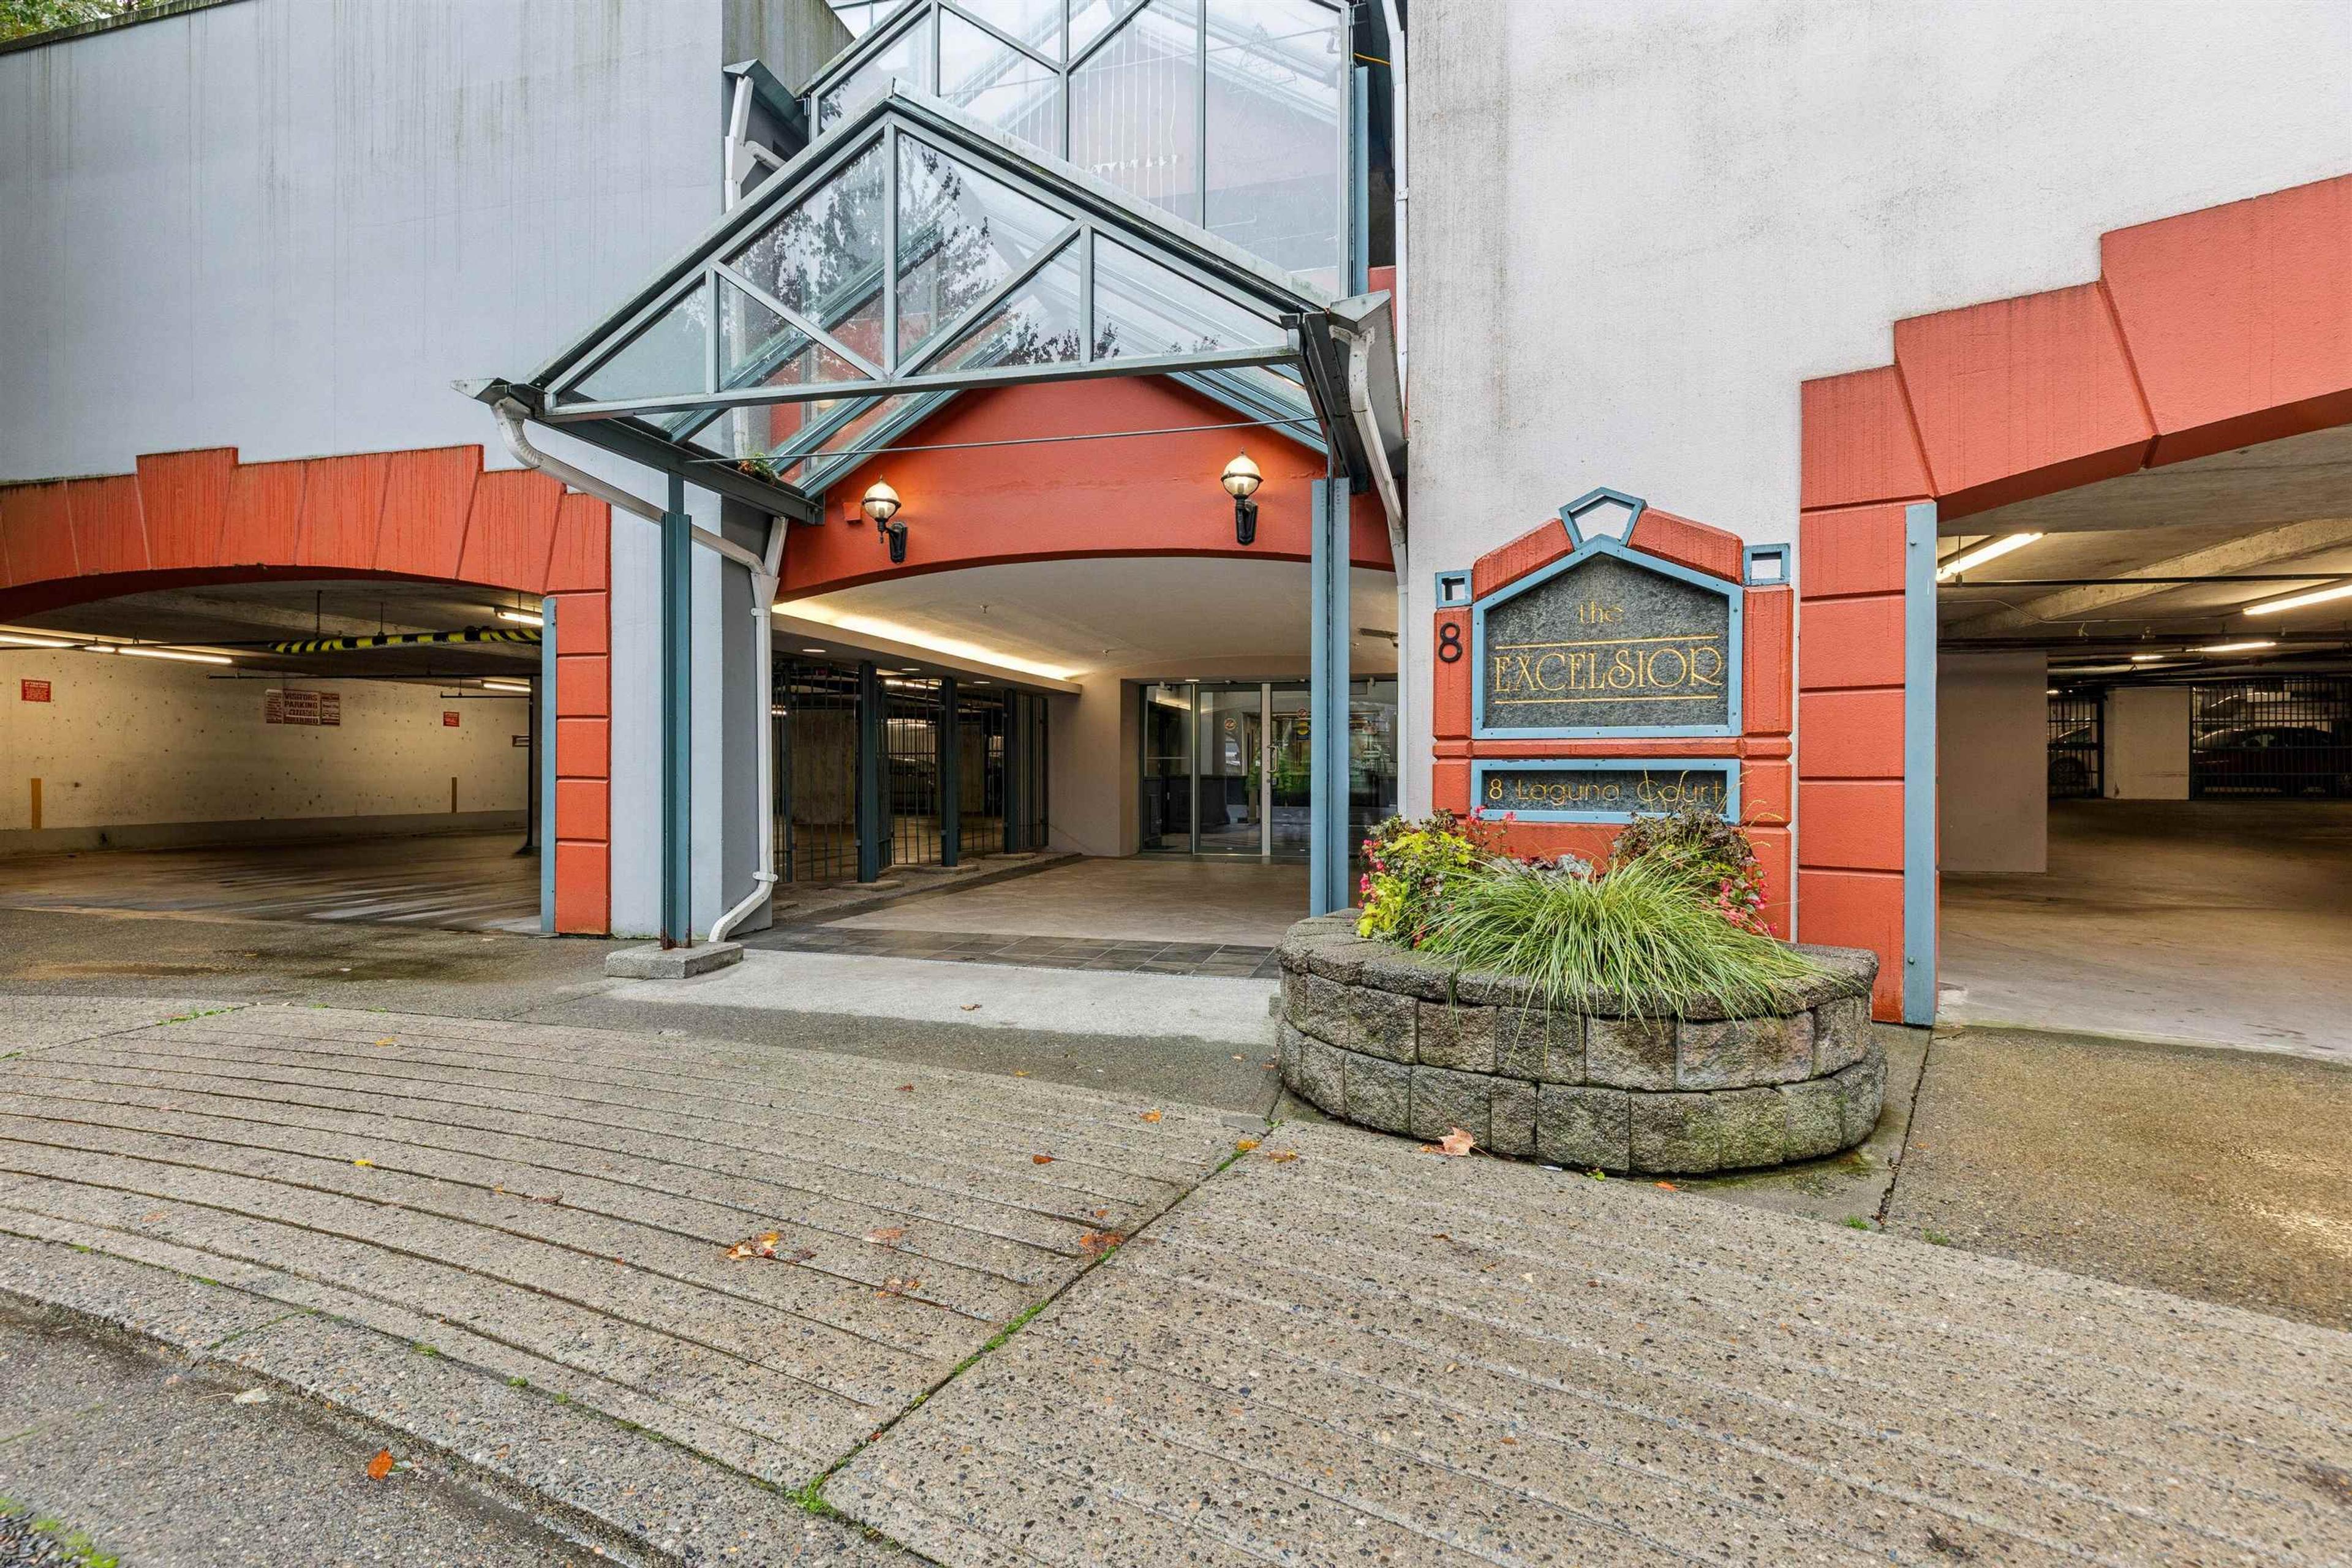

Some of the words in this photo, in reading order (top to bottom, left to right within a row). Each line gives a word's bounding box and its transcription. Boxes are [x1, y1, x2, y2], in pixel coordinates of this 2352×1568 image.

[1579, 601, 1624, 625] the
[1438, 622, 1463, 663] 8
[1494, 647, 1723, 692] EXCELSIOR
[284, 701, 318, 709] PARKING
[1489, 778, 1503, 800] 8
[1518, 779, 1620, 806] Laguna
[1637, 779, 1724, 803] Court
